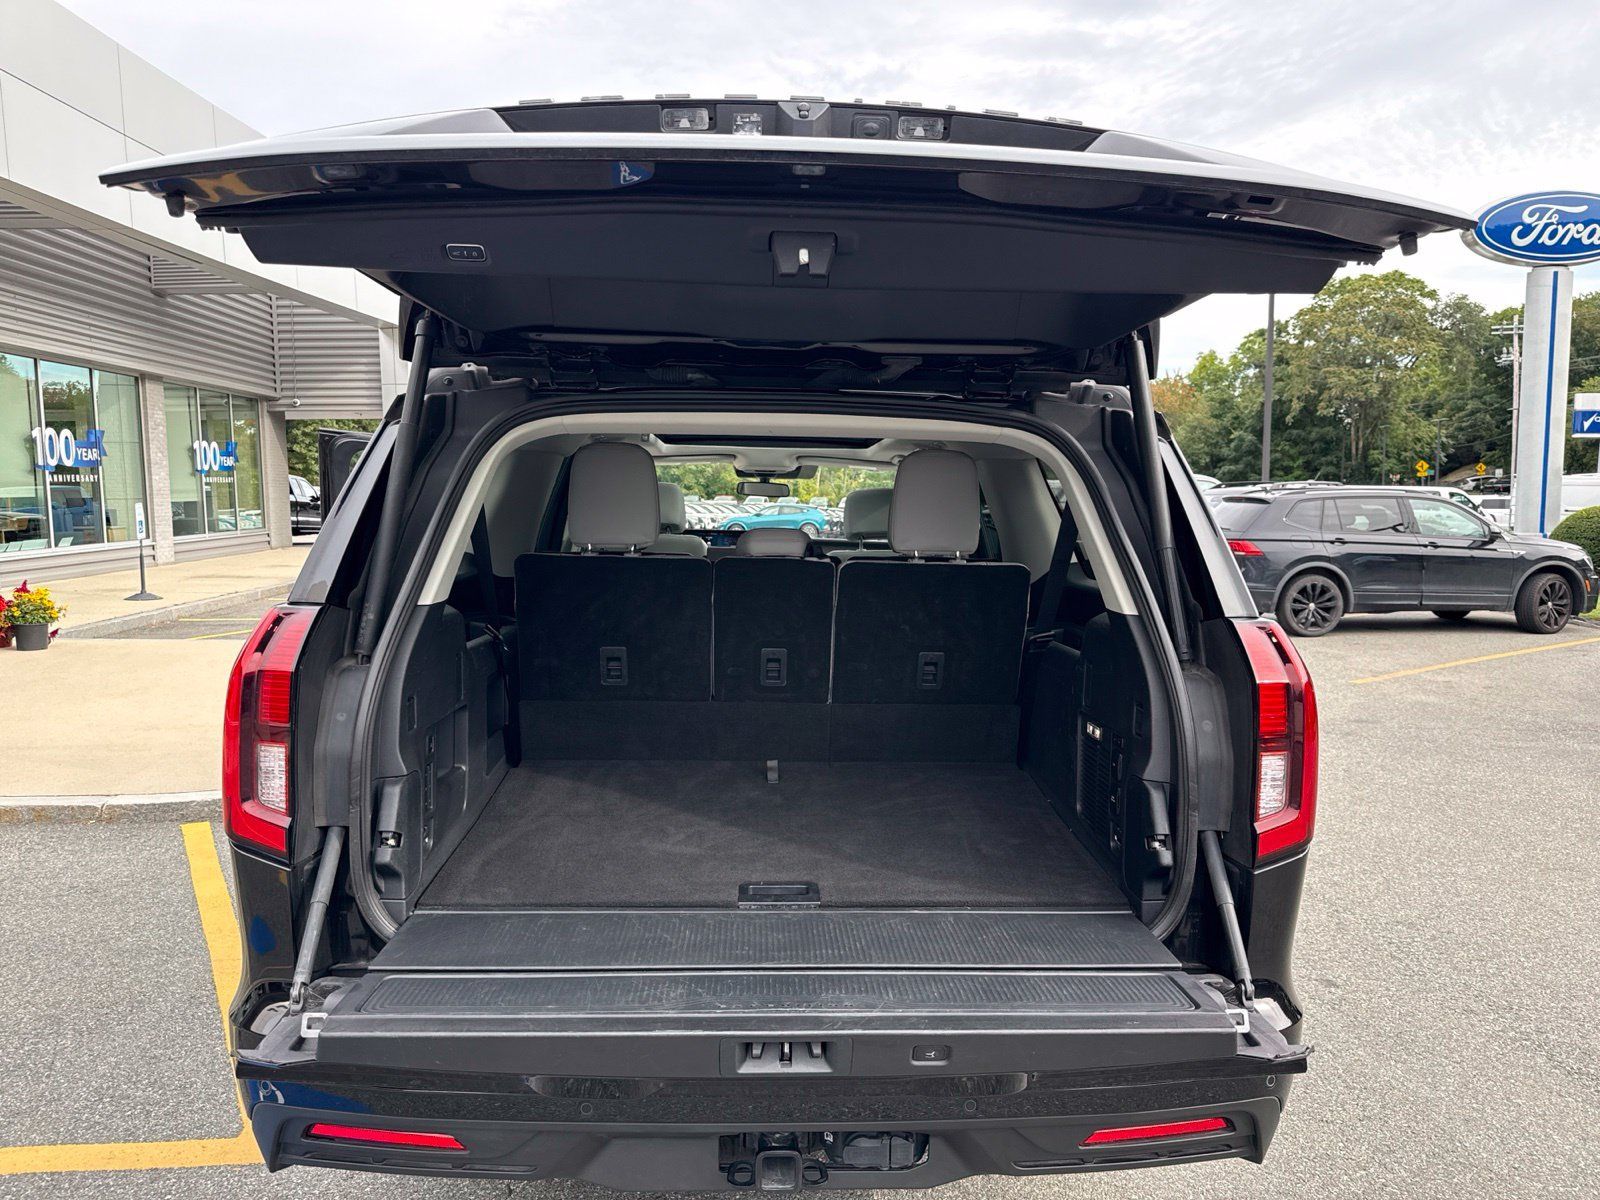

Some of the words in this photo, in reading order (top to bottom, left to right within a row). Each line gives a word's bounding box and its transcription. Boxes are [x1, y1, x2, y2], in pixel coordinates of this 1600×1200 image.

[31, 426, 76, 467] 100
[193, 440, 220, 471] 100
[48, 474, 98, 482] ANNIVERSARY
